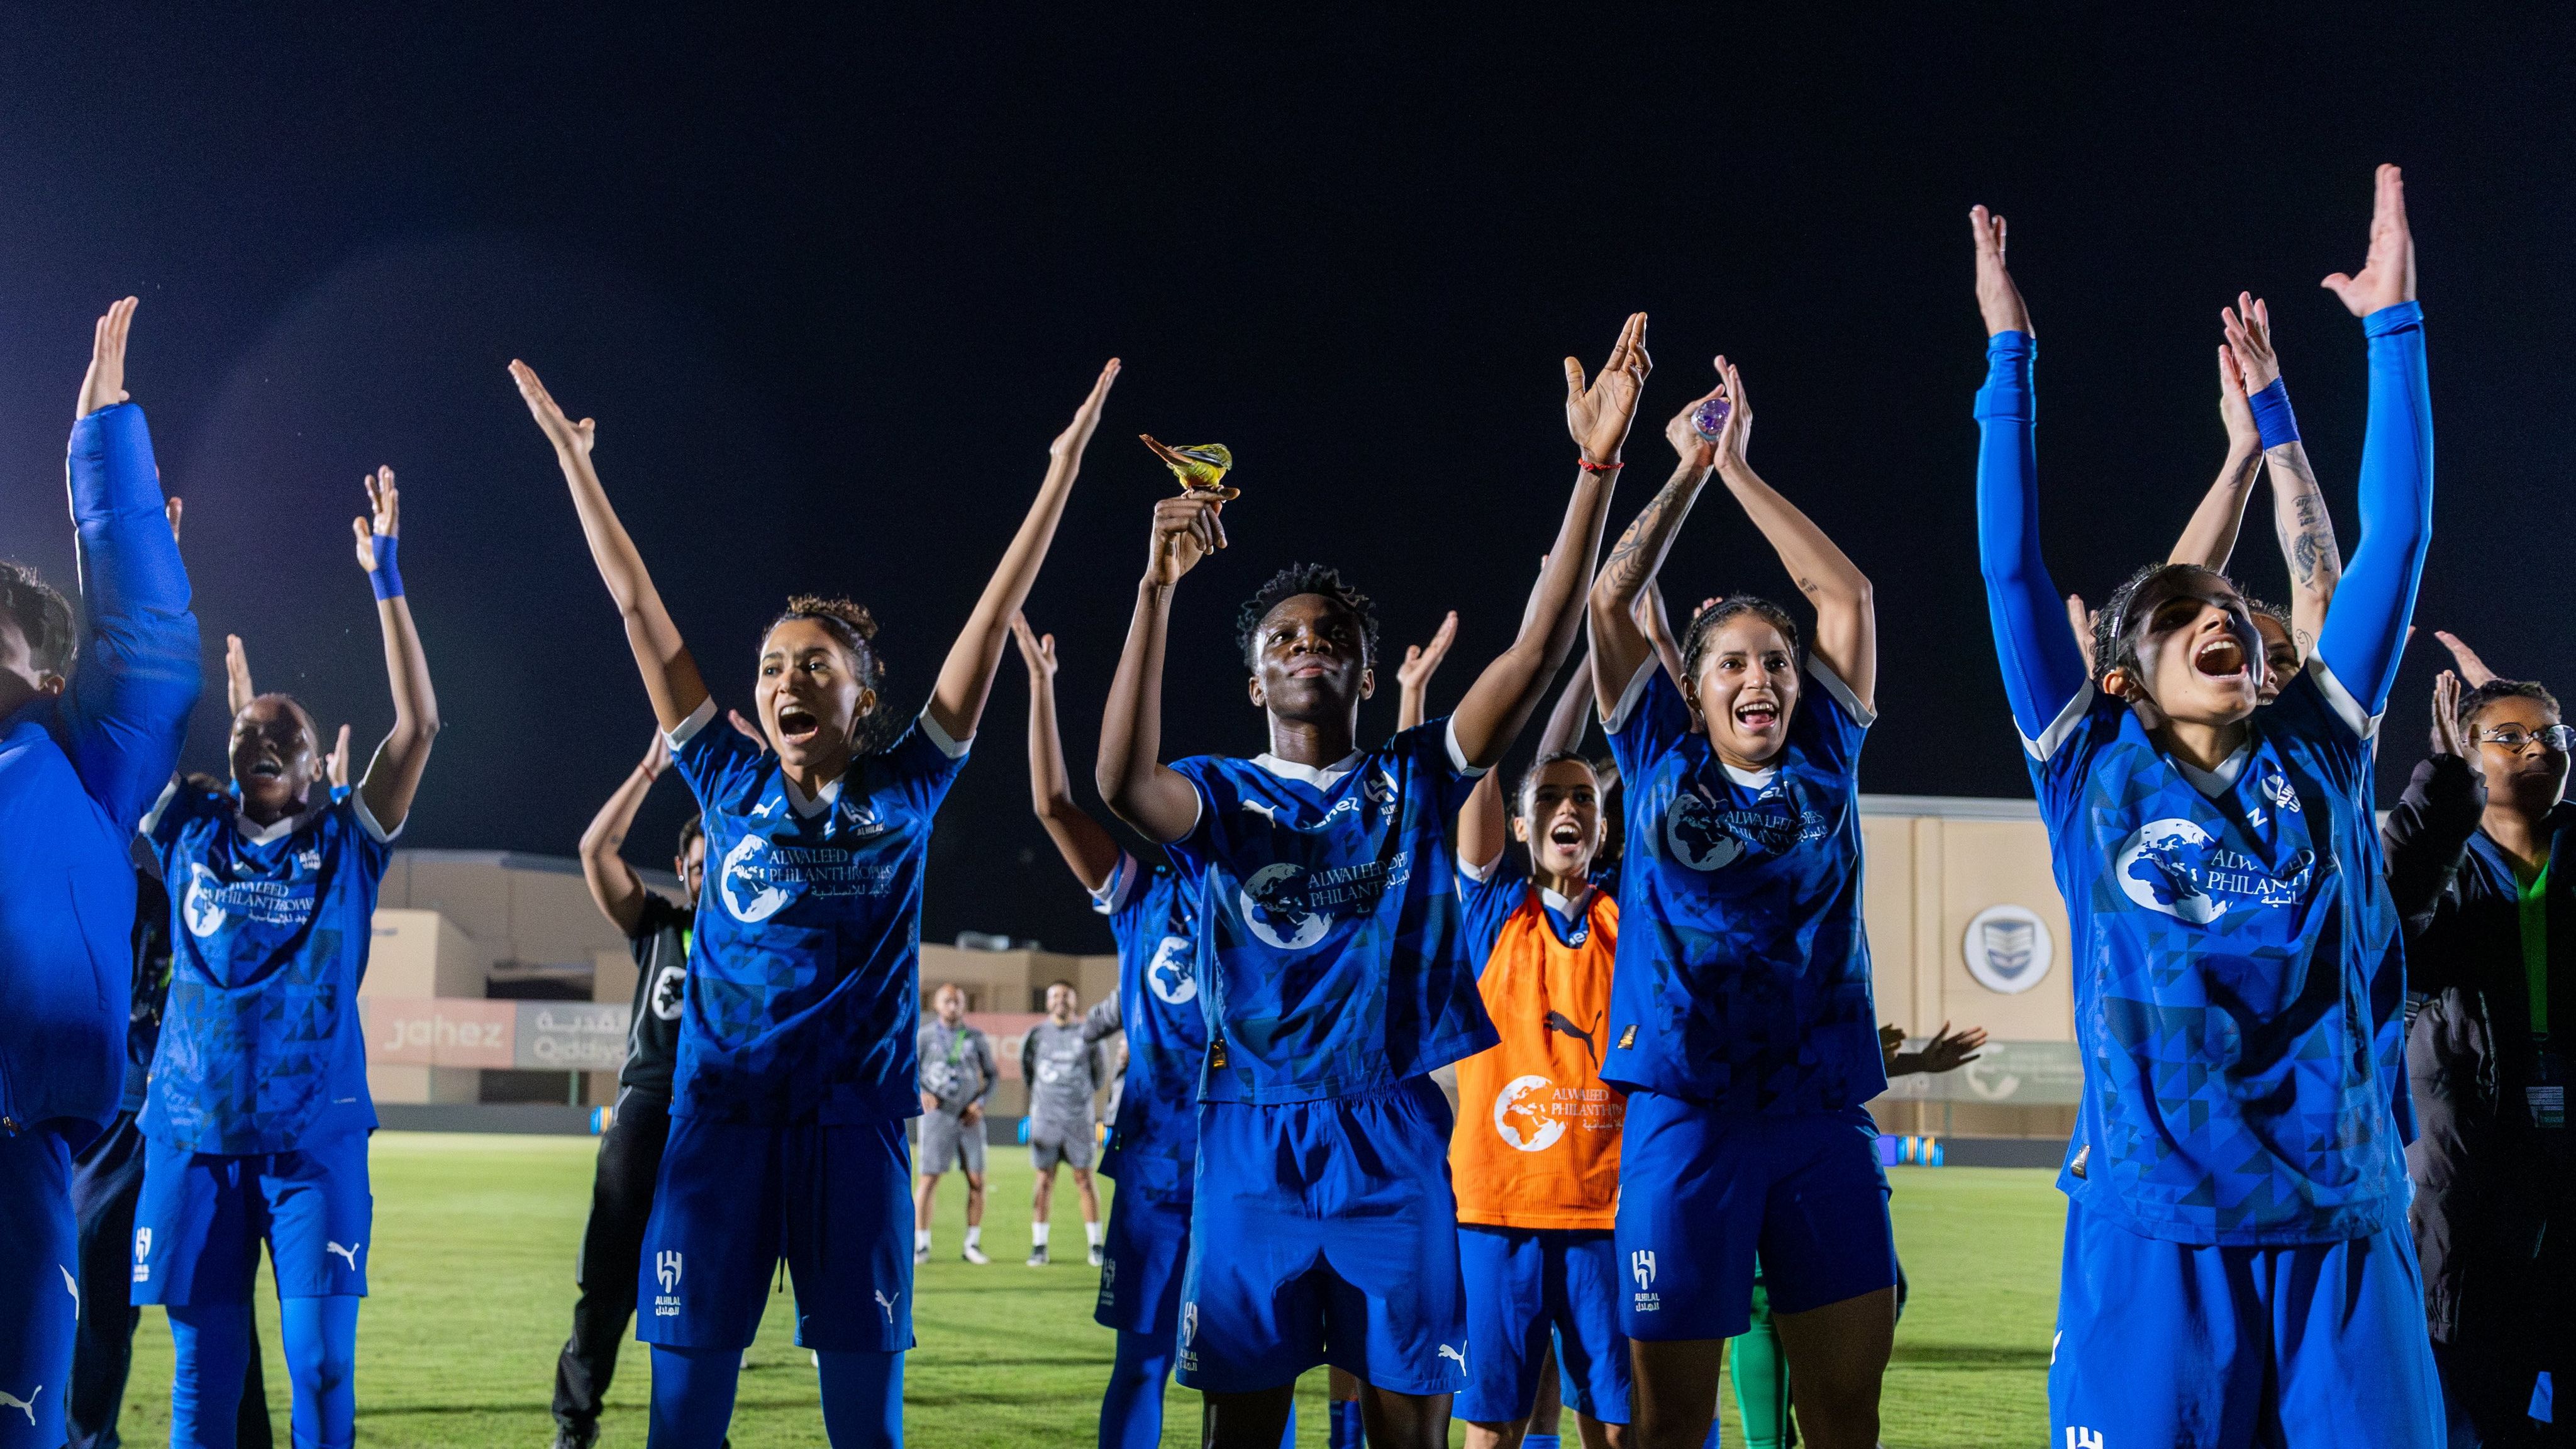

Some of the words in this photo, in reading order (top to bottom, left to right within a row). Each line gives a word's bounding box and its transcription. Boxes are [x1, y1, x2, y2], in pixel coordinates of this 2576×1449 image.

[769, 849, 849, 865] ALWALEED
[1308, 860, 1387, 889] ALWALEED
[384, 1015, 502, 1052] jahez
[1552, 1088, 1609, 1101] ALWALEED
